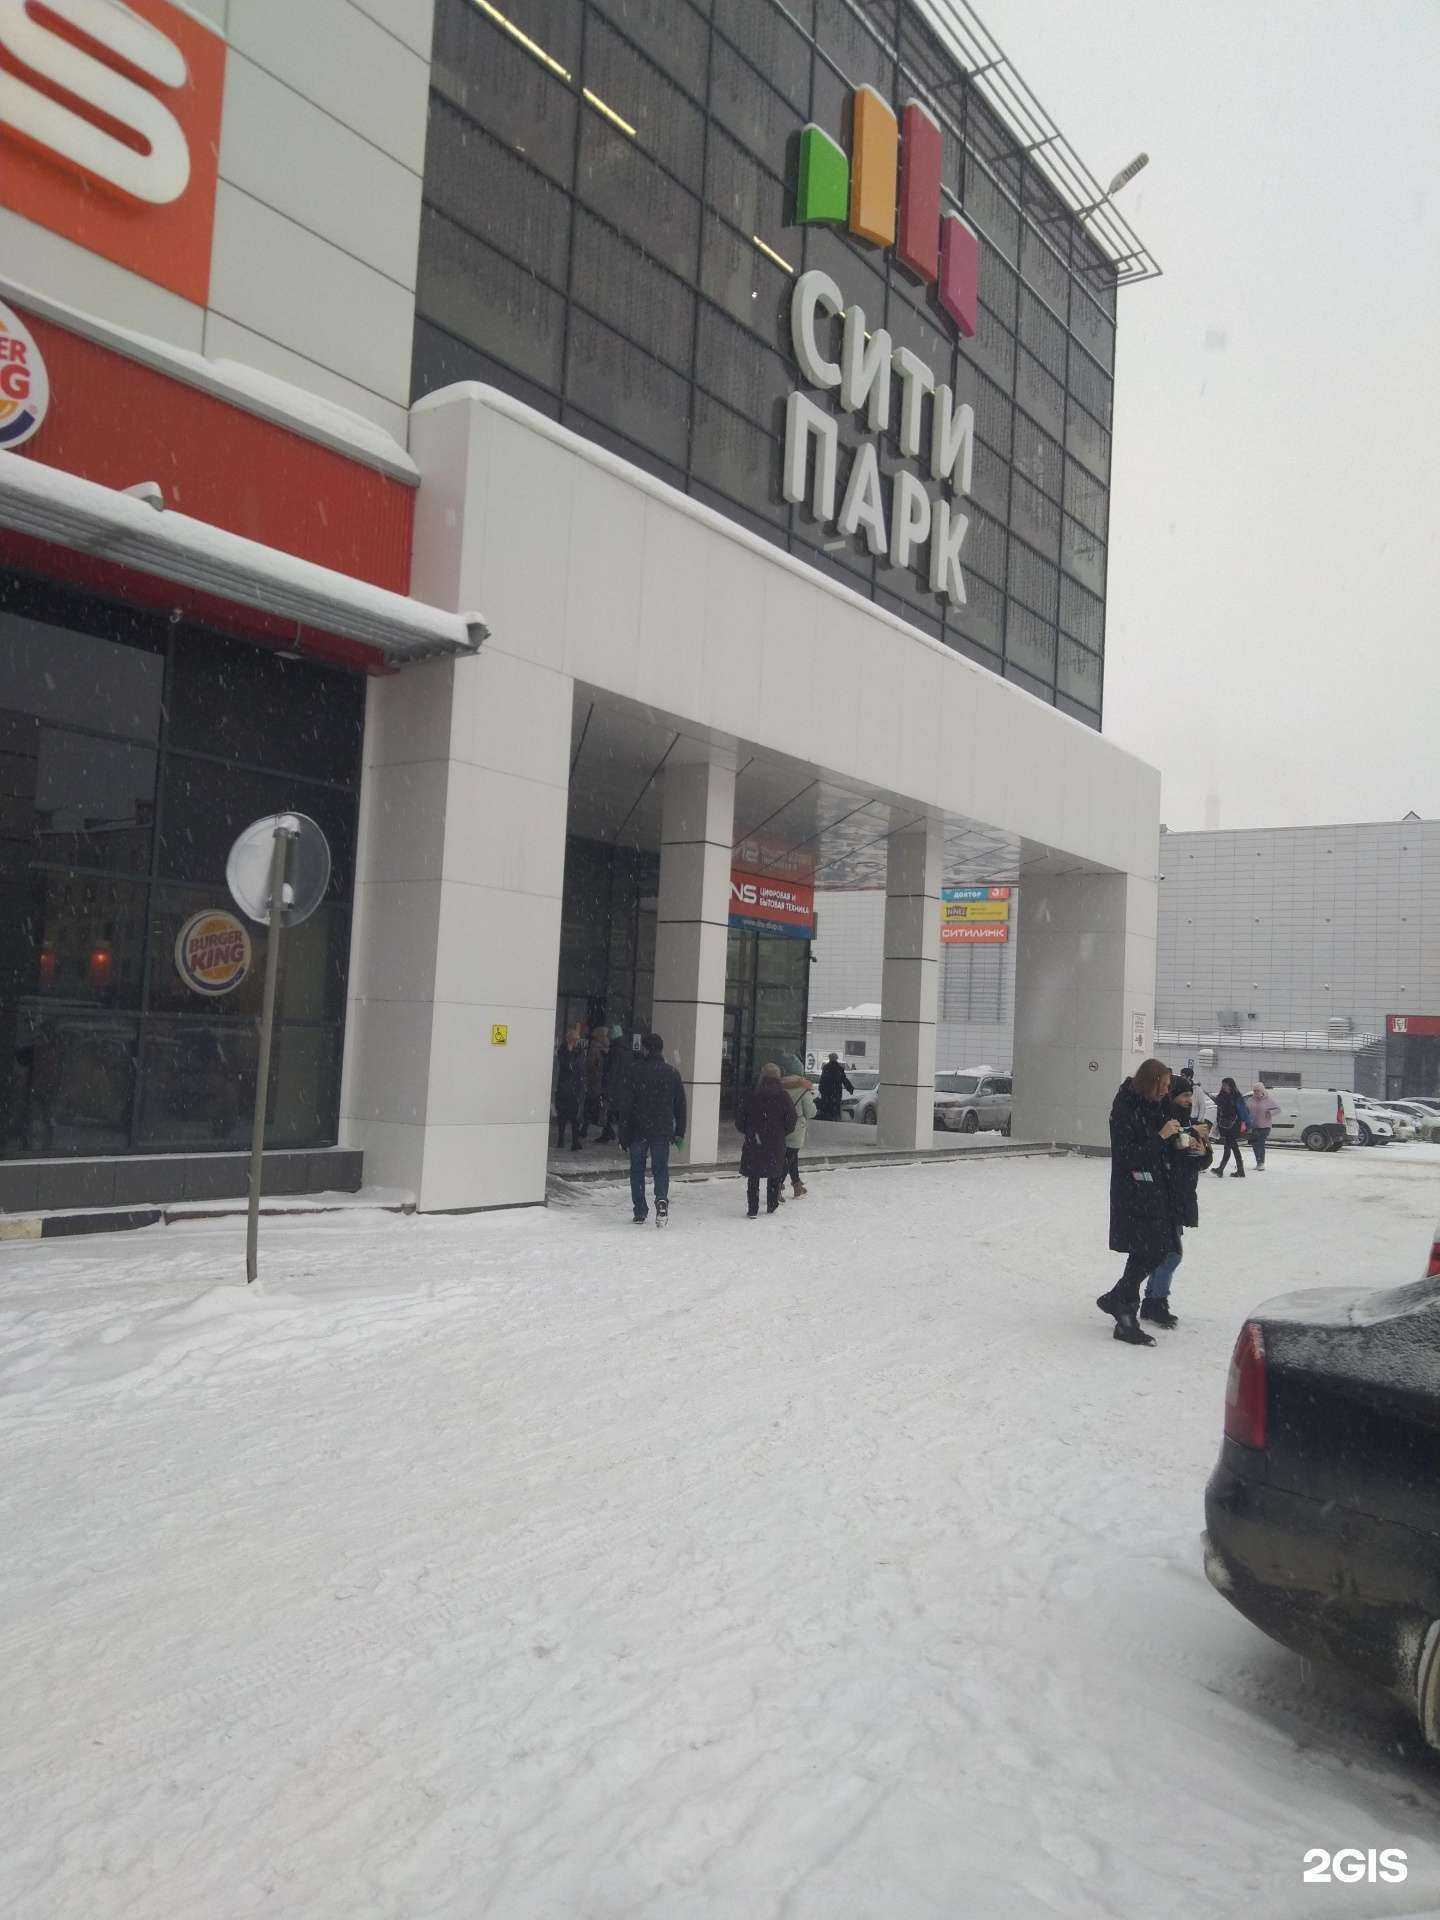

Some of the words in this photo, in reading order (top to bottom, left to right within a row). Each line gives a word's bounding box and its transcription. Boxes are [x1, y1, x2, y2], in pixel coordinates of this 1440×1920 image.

[791, 269, 974, 497] СИТИ
[783, 390, 969, 605] ПАРК
[760, 887, 791, 900] ЦИФРОВАЯ
[760, 898, 785, 910] БЫТОВАЯ
[786, 902, 809, 914] ТЕХНИКА
[190, 929, 243, 954] BURGER
[942, 929, 1006, 938] СИТИЛИНК
[190, 943, 245, 970] KING
